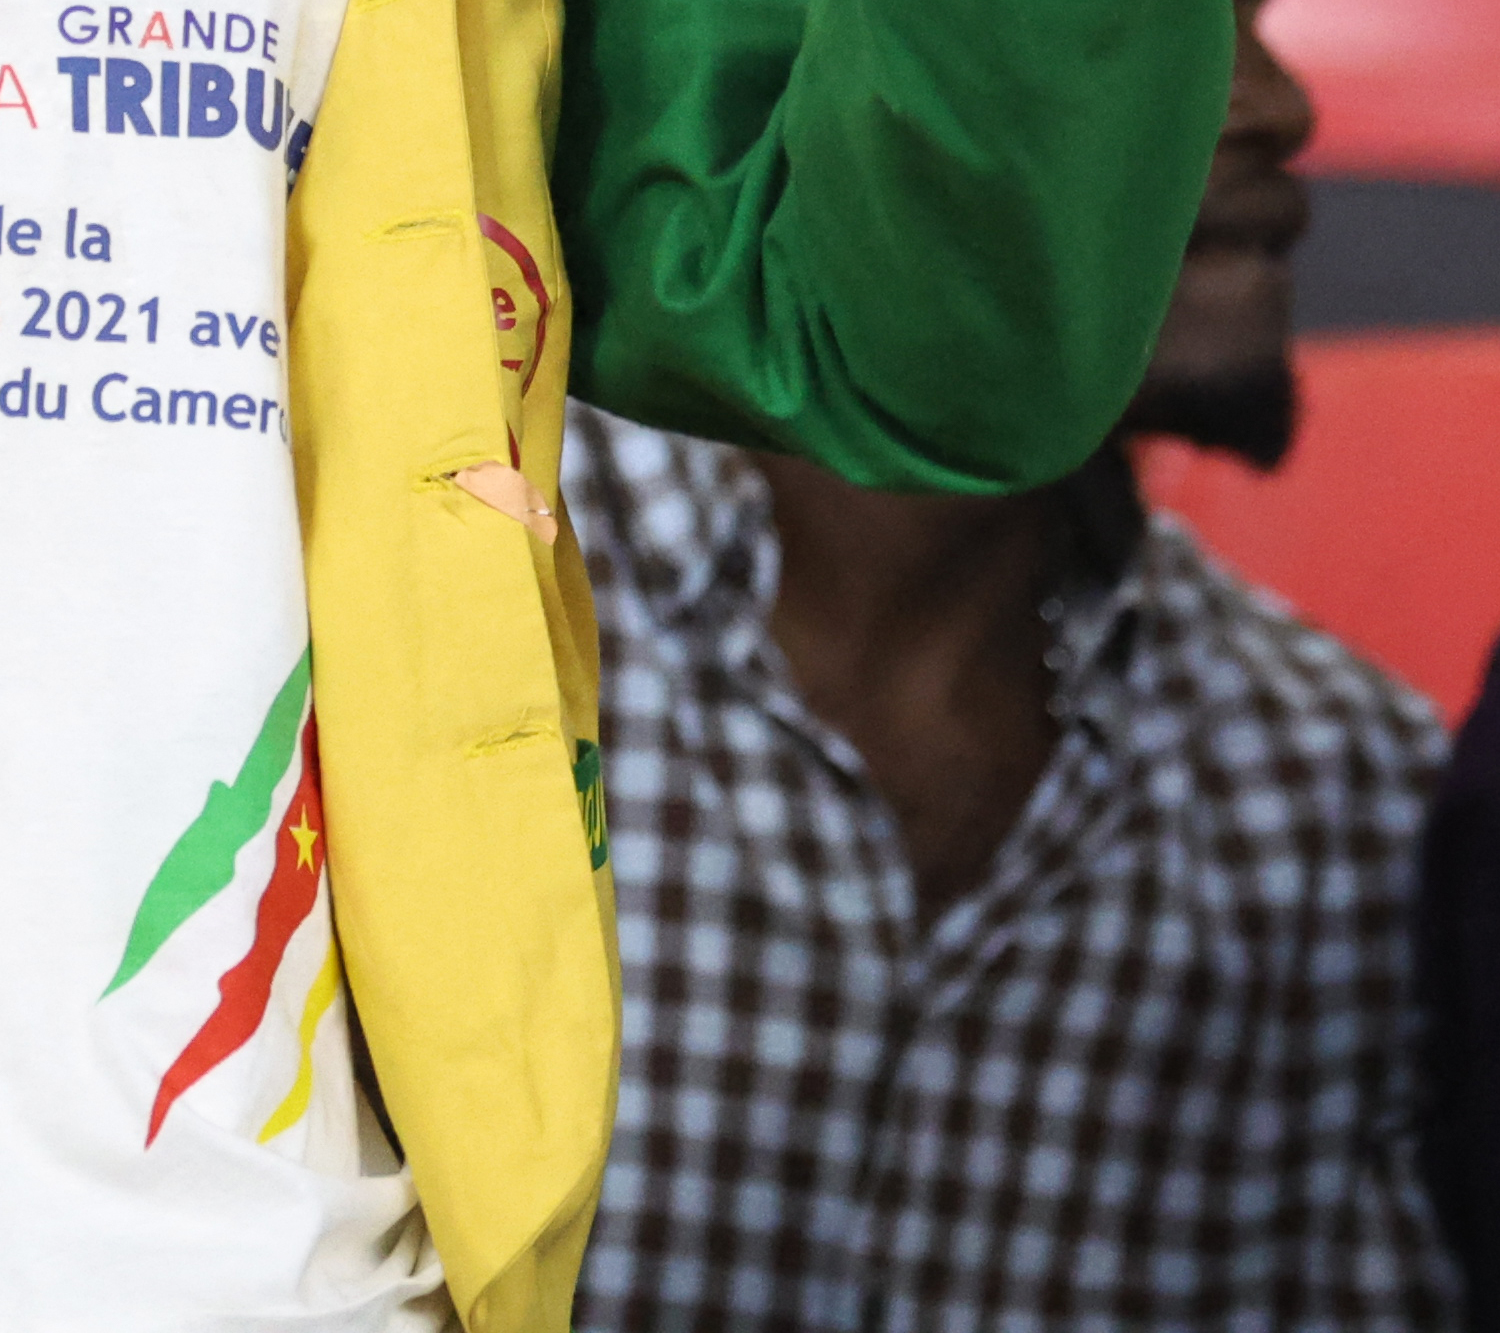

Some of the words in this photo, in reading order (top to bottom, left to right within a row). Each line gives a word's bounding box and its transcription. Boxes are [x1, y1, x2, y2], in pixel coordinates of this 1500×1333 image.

[57, 5, 280, 62] GRANDE
[65, 208, 112, 262] la
[19, 287, 160, 343] 2021
[189, 310, 281, 358] ave
